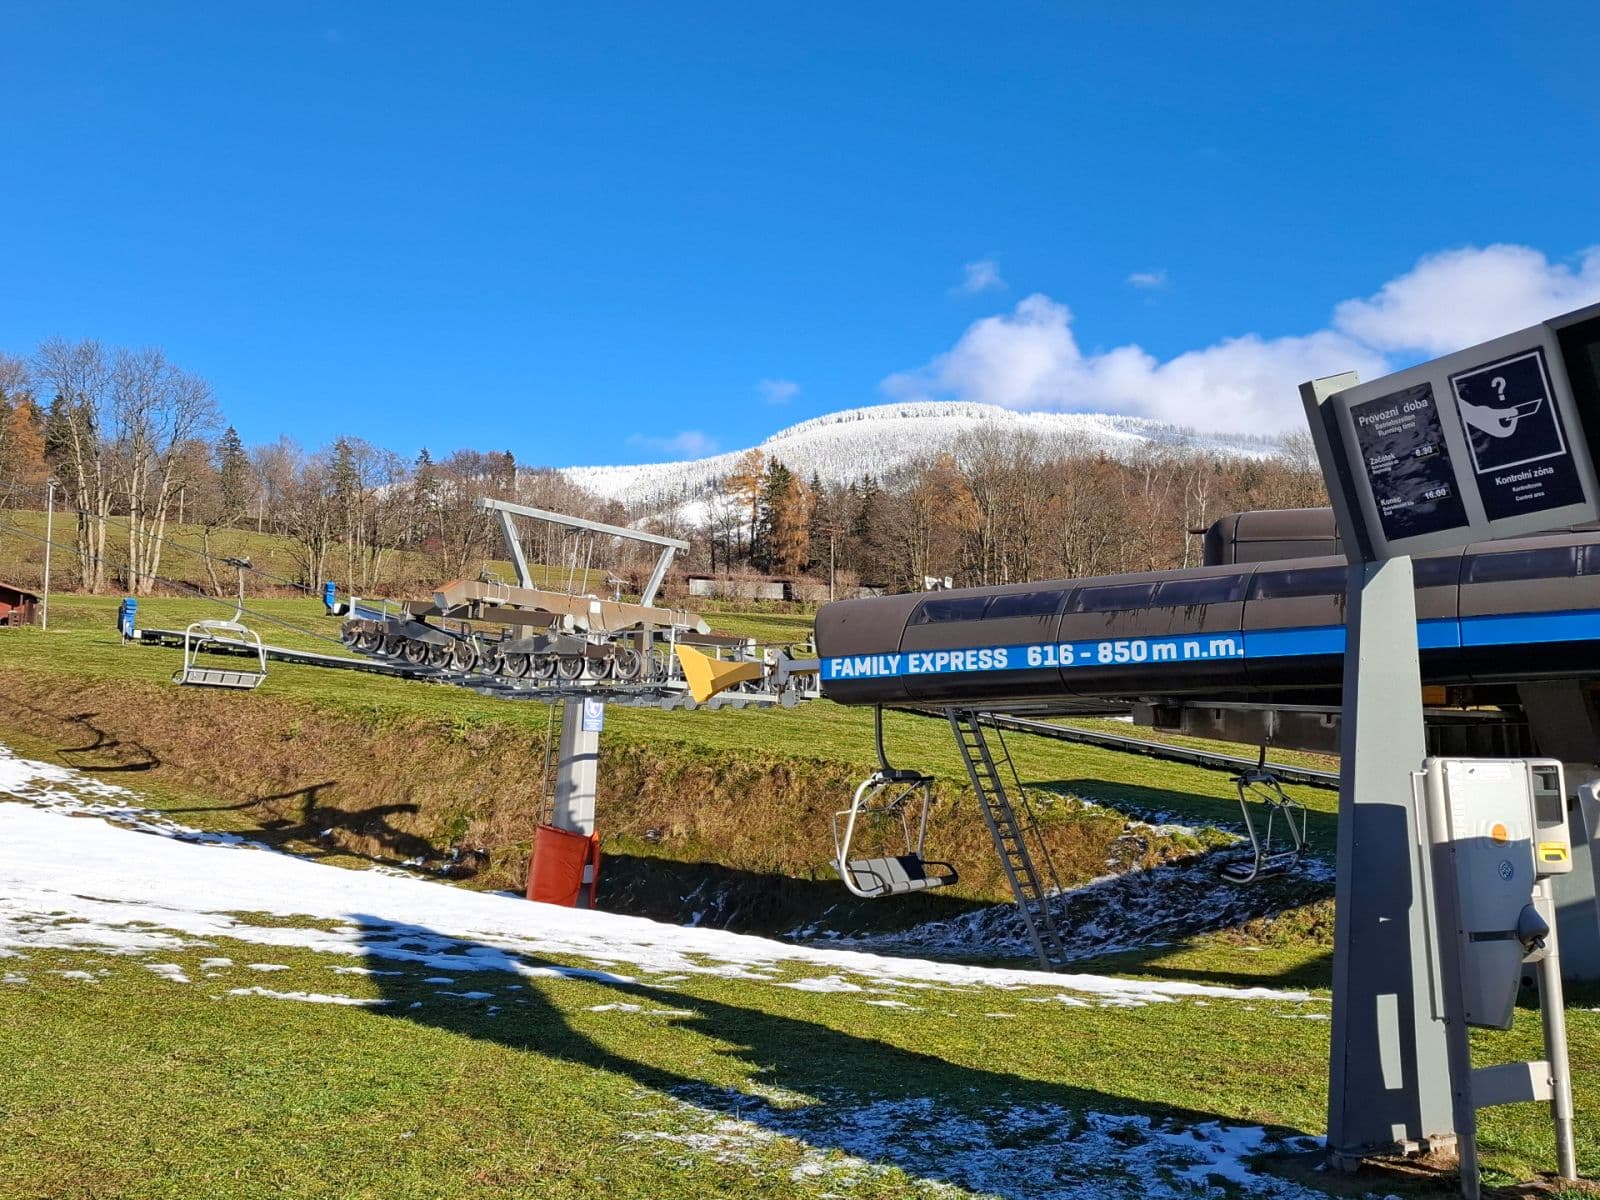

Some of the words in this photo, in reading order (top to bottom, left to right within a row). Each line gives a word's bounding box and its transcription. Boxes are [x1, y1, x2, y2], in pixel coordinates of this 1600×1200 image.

[1403, 399, 1429, 413] doba
[1495, 468, 1533, 486] Kontrolní
[1533, 466, 1554, 477] zóna
[831, 655, 901, 677] FAMILY
[909, 648, 1008, 673] EXPRESS
[1027, 644, 1074, 667] 616
[1098, 640, 1148, 663] 850
[1184, 638, 1244, 659] n.m.
